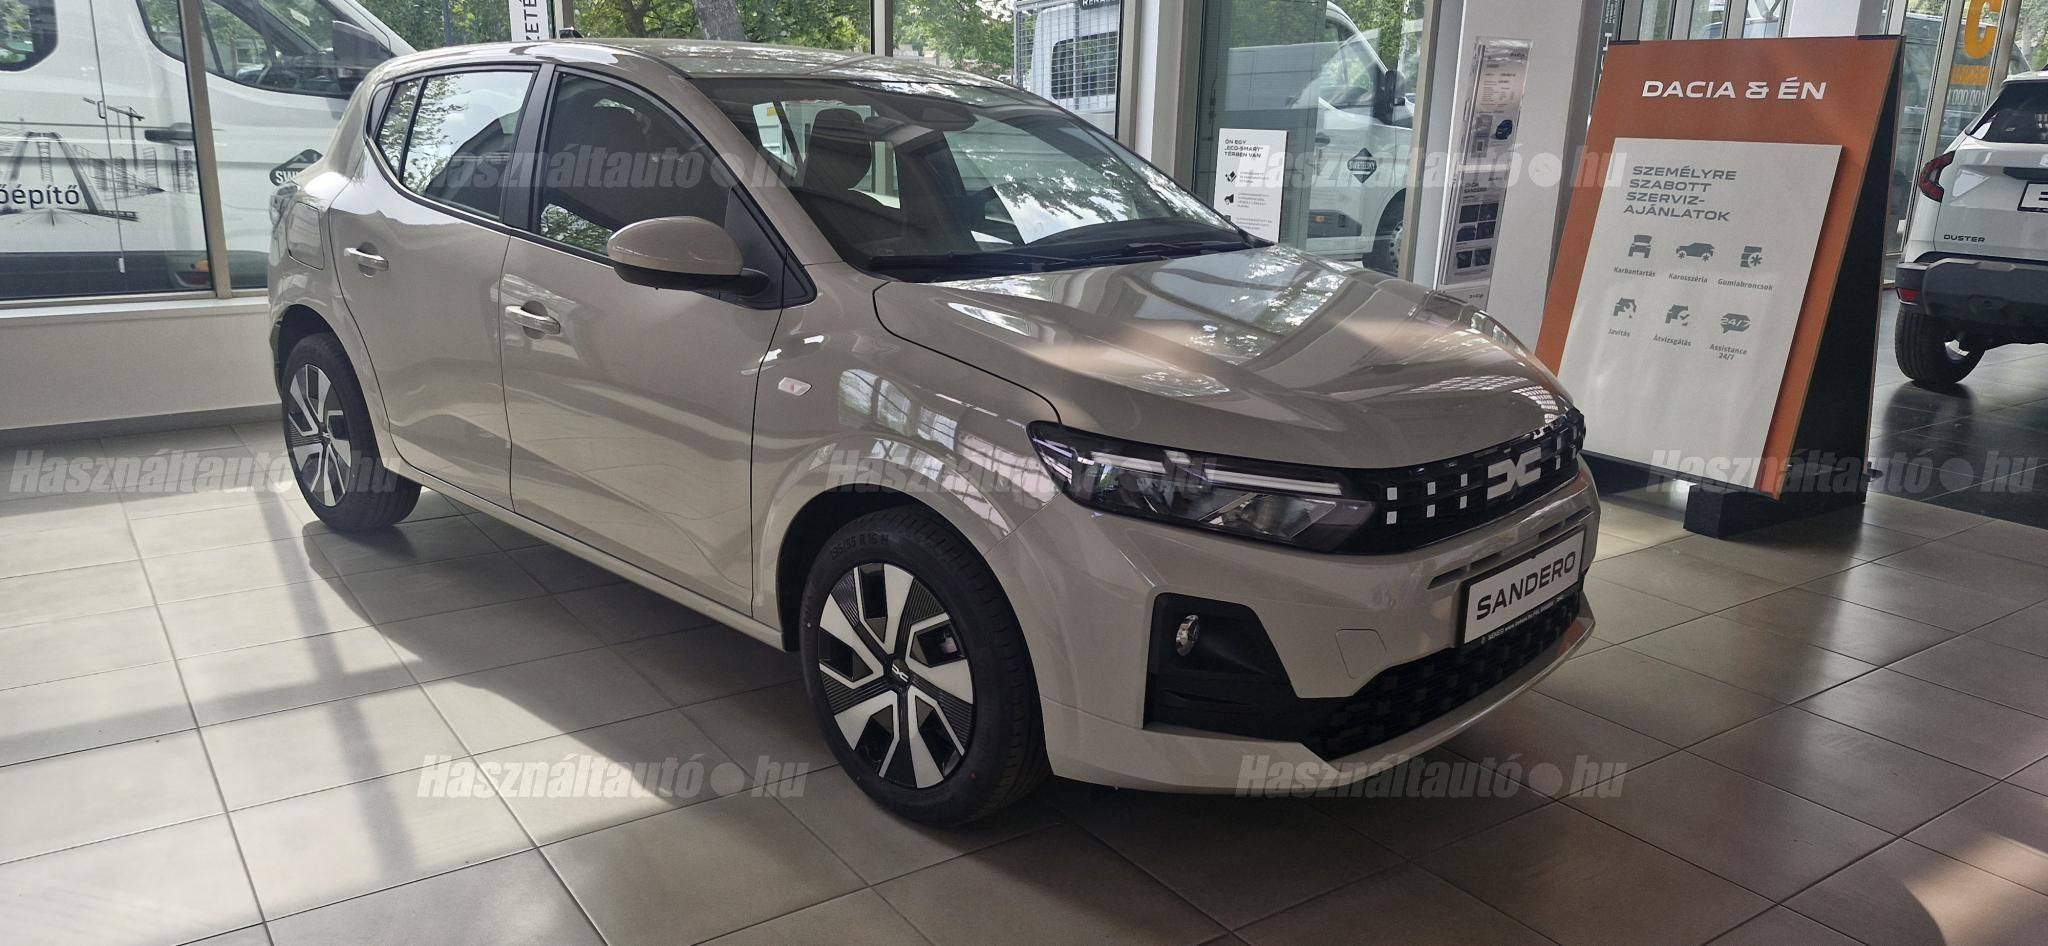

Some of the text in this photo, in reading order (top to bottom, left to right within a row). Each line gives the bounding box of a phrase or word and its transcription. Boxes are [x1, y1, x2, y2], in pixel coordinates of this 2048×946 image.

[1641, 76, 1827, 100] DACIA & ÉN
[1632, 165, 1737, 180] SZEMÉLYRE
[1629, 179, 1712, 193] SZABOTT
[1626, 191, 1706, 206] SZERVIZ-
[1623, 203, 1731, 222] AJÁNLATOK
[1943, 234, 1986, 243] DUSTER
[1613, 266, 1657, 278] Karbantartás
[1668, 273, 1708, 284] Karosszéria
[1717, 278, 1773, 291] Gumiabroncsok
[1607, 328, 1631, 338] Javítás
[1653, 333, 1692, 347] Átvizsgálás
[1709, 343, 1748, 356] Assistance
[1718, 352, 1735, 361] 24/7
[1476, 551, 1576, 621] SANDERO
